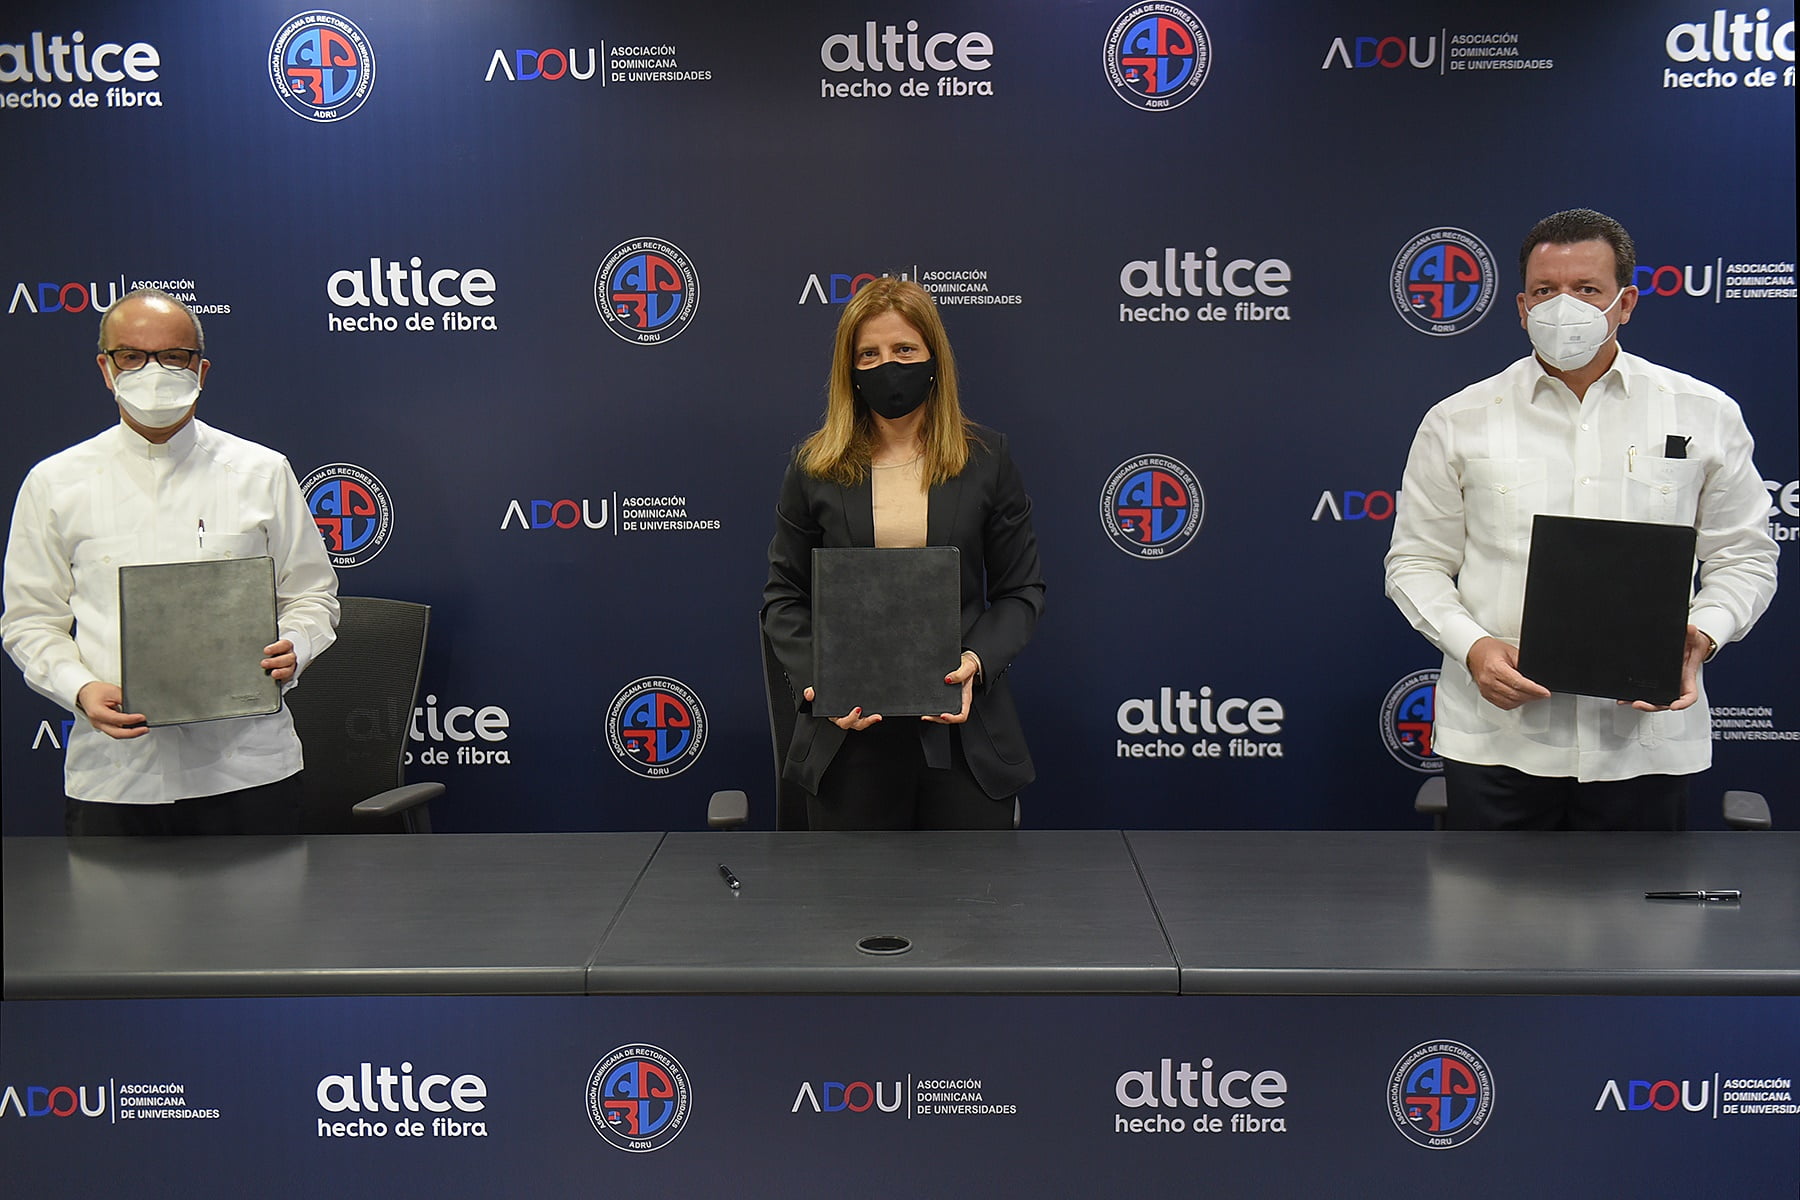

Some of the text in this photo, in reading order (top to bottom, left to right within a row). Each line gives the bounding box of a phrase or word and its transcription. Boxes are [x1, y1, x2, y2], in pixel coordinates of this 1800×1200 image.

[1155, 4, 1191, 22] RECTORES
[1111, 8, 1143, 43] DOMINICANA
[1189, 19, 1198, 31] DE
[1451, 33, 1518, 44] ASOCIACIÓN
[1666, 8, 1795, 62] altic
[611, 44, 675, 56] ASOCIACIÓN
[821, 20, 993, 71] altice
[1322, 36, 1436, 69] ADOU
[1451, 48, 1519, 57] DOMINICANA
[0, 31, 160, 82] altice
[276, 19, 305, 53] DOMINICANA
[317, 16, 352, 33] RECTORES
[351, 31, 361, 42] DE
[356, 41, 370, 98] UNIVERSIDADES
[485, 48, 595, 81] ADOU
[611, 59, 677, 68] DOMINICANA
[1190, 29, 1206, 87] UNIVERSIDADES
[1451, 60, 1553, 70] DE UNIVERSIDADES
[612, 71, 711, 81] DE UNIVERSIDADES
[1663, 68, 1738, 88] hecho
[1744, 66, 1777, 88] de
[822, 77, 993, 97] hecho de fibra
[69, 88, 99, 108] de
[106, 87, 162, 107] fibra
[314, 110, 337, 118] ADRU
[643, 242, 678, 259] RECTORES
[601, 245, 632, 280] DOMINICANA
[677, 257, 686, 269] DE
[1726, 261, 1794, 273] ASOCIACIÓN
[923, 269, 987, 280] ASOCIACIÓN
[1120, 247, 1291, 297] altice
[130, 278, 195, 290] ASOCIACIÓN
[327, 257, 496, 306] altice
[799, 273, 907, 304] AD
[924, 284, 988, 293] DOMINICANA
[1631, 265, 1712, 297] DOU
[1726, 277, 1795, 286] DOMINICANA
[8, 282, 116, 313] ADOU
[680, 266, 695, 321] UNIVERSIDADES
[940, 296, 1022, 305] UNIVERSIDADES
[1725, 288, 1797, 298] DE UNIVERSID
[187, 305, 231, 314] SIDADES
[1120, 302, 1290, 321] hecho de fibra
[329, 312, 497, 331] hecho de fibra
[638, 334, 660, 342] ADRU
[1150, 459, 1185, 476] RECTORES
[338, 468, 373, 485] RECTORES
[1107, 462, 1138, 495] DOMINICANA
[1182, 473, 1192, 484] DE
[370, 483, 380, 494] DE
[623, 496, 685, 506] ASOCIACIÓN
[500, 499, 608, 530] ADOU
[623, 509, 687, 518] DOMINICANA
[1185, 483, 1200, 537] UNIVERSIDADES
[374, 493, 388, 545] UNIVERSIDADES
[623, 521, 720, 530] DE UNIVERSIDADES
[1769, 522, 1799, 541] ibr
[1141, 547, 1163, 555] ADRU
[653, 681, 688, 698] RECTORES
[612, 685, 642, 716] DOMINICANA
[685, 694, 694, 705] DE
[409, 694, 510, 742] tice
[1117, 686, 1283, 734] altice
[1710, 706, 1772, 716] ASOCIACIÓN
[688, 703, 703, 756] UNIVERSIDADES
[1723, 731, 1800, 740] UNIVERSIDADE
[421, 747, 449, 765] de
[456, 747, 511, 765] fibra
[1117, 739, 1283, 757] hecho de fibra
[636, 1049, 671, 1066] RECTORES
[593, 1052, 624, 1086] DOMINICANA
[668, 1064, 678, 1074] DE
[120, 1083, 184, 1094] ASOCIACIÓN
[317, 1062, 487, 1112] altice
[917, 1078, 981, 1089] ASOCIACIÓN
[1116, 1058, 1287, 1108] altice
[1724, 1077, 1791, 1088] ASOCIACIÓN
[0, 1086, 105, 1117] ADOU
[121, 1097, 185, 1106] DOMINICANA
[672, 1073, 687, 1129] UNIVERSIDADES
[792, 1082, 901, 1112] ADOU
[917, 1093, 982, 1101] DOMINICANA
[1595, 1080, 1709, 1111] ADOU
[1723, 1093, 1791, 1101] DOMINICANA
[121, 1110, 219, 1119] DE UNIVERSIDADES
[917, 1105, 1016, 1114] DE UNIVERSIDADES
[1723, 1105, 1800, 1113] DE UNIVERSIDA
[318, 1118, 487, 1137] hecho de fibra
[1115, 1114, 1286, 1132] hecho de fibra
[629, 1141, 651, 1149] ADRU
